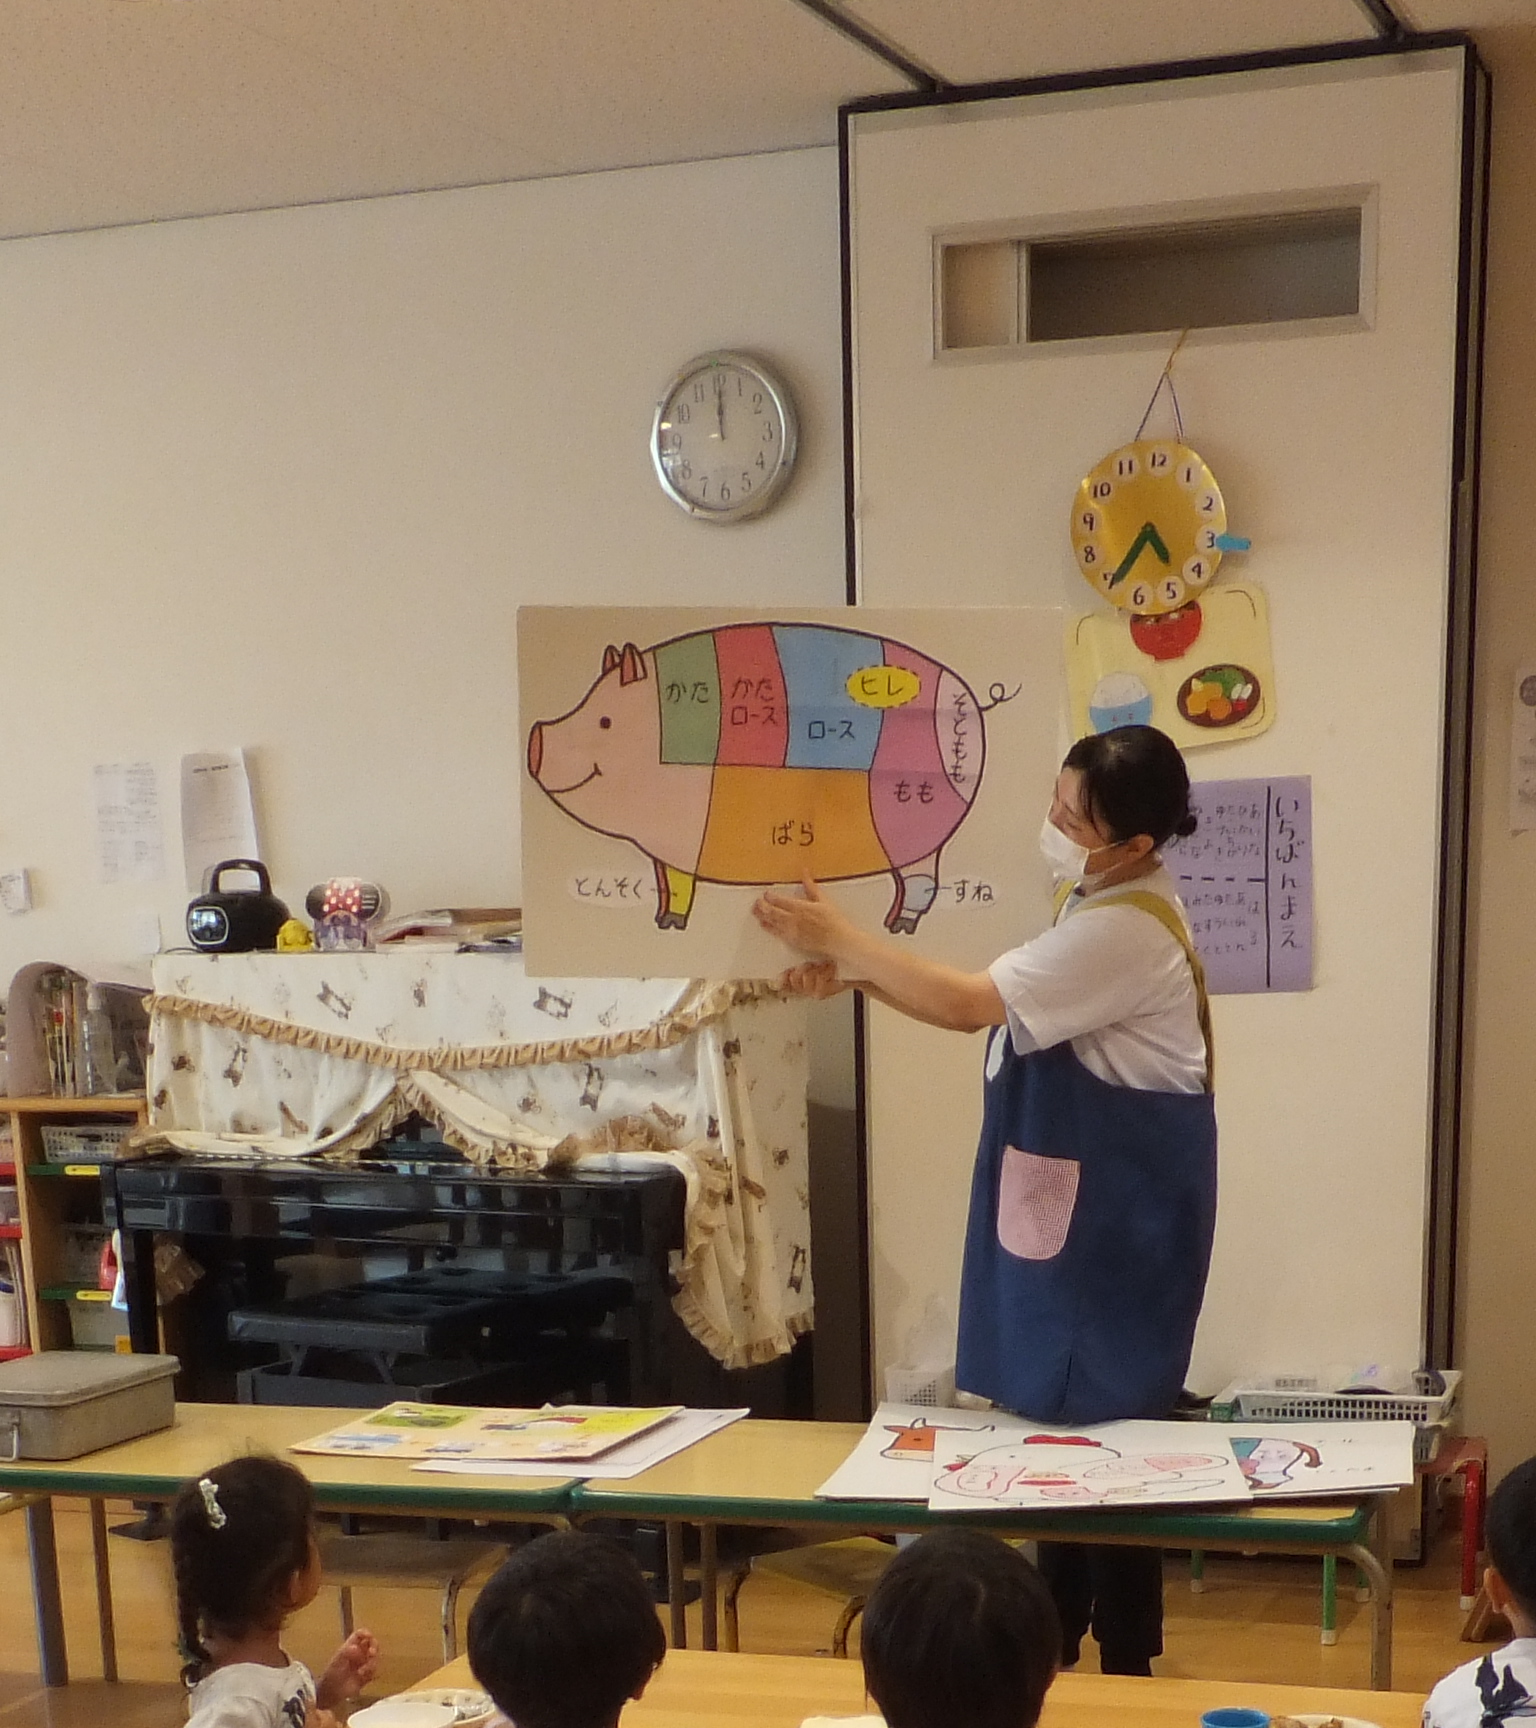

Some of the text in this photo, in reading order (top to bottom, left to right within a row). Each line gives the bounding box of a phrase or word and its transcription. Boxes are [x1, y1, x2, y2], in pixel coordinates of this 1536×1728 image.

[693, 384, 705, 403] 11
[737, 377, 743, 397] 1
[752, 392, 763, 414] 2
[677, 404, 691, 424] 10
[762, 421, 773, 442] 3
[681, 459, 692, 479] 8
[755, 451, 765, 470] 4
[1118, 460, 1133, 476] 11
[1151, 452, 1168, 468] 12
[741, 472, 752, 492] 5
[1185, 467, 1191, 483] 1
[699, 477, 709, 498] 7
[720, 481, 731, 501] 6
[1092, 482, 1111, 498] 10
[1202, 496, 1214, 511] 2
[1082, 513, 1095, 531] 9
[1206, 531, 1216, 549] 3
[1084, 546, 1096, 563] 8
[1191, 562, 1202, 579] 4
[1133, 586, 1145, 605] 6
[1166, 582, 1177, 600] 5
[665, 680, 710, 704] かた
[731, 676, 775, 702] かた
[860, 676, 904, 697] ヒレ
[731, 706, 778, 727] ロース
[808, 720, 856, 740] ロース
[893, 780, 934, 804] もも
[770, 821, 816, 847] ばら
[574, 877, 644, 899] とんそく
[953, 881, 995, 904] すね
